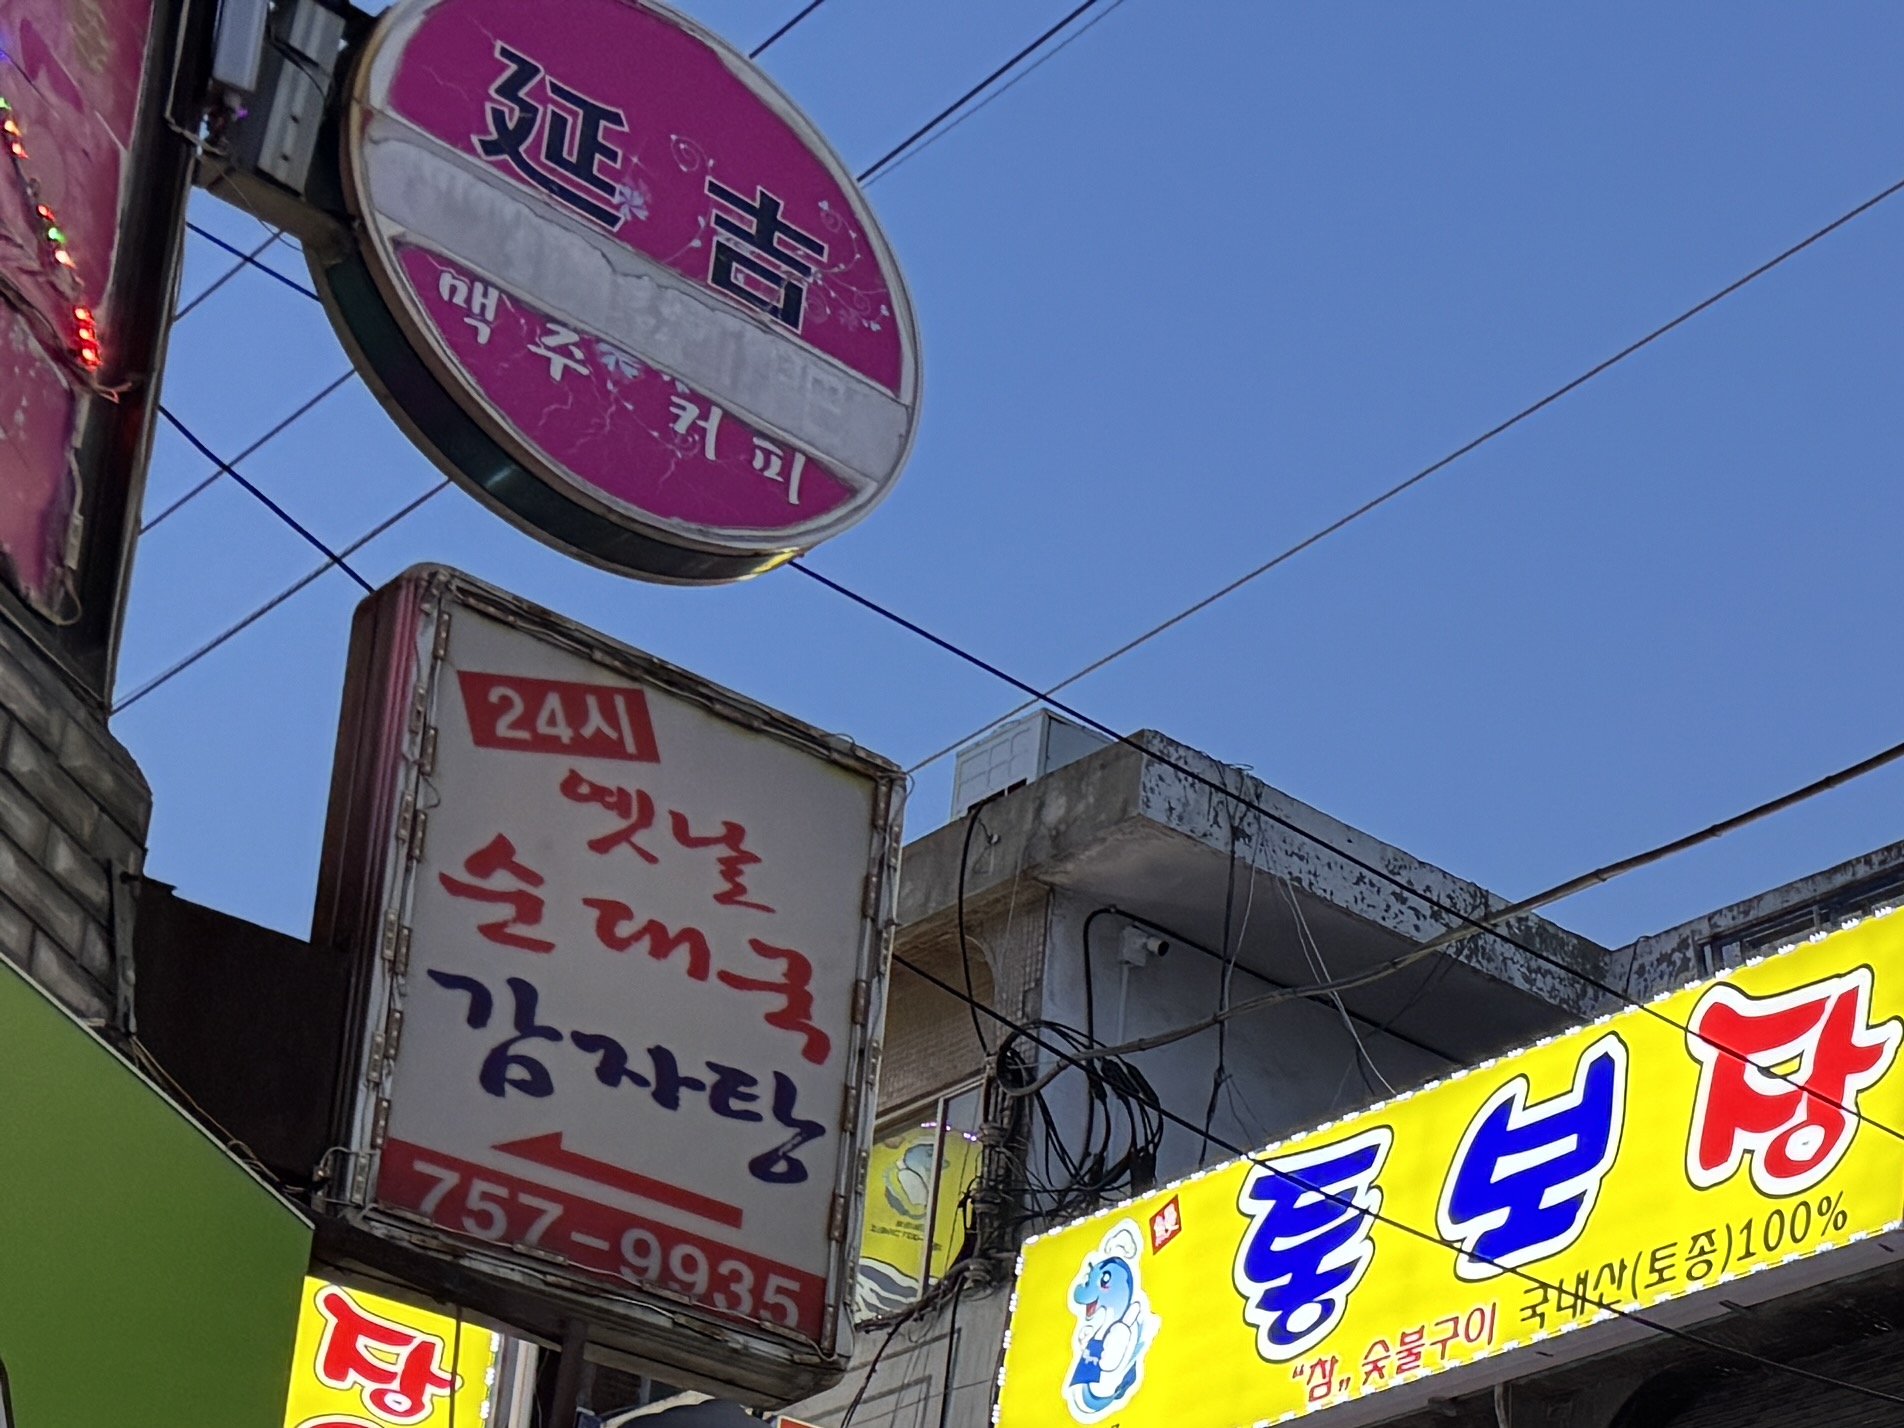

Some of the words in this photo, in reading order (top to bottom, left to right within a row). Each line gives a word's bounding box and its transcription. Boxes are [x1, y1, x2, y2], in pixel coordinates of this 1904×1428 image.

[471, 40, 828, 333] 延吉
[438, 268, 592, 384] 맥주
[668, 394, 806, 506] 커피
[487, 685, 638, 756] 24시
[559, 768, 777, 914] 옛날
[438, 833, 832, 1065] 순대국
[427, 969, 827, 1185] 감자탕
[411, 1158, 802, 1332] 757-9935
[1361, 1301, 1499, 1386] 숯불구이
[1519, 1189, 1850, 1330] 국내산(토종)100%
